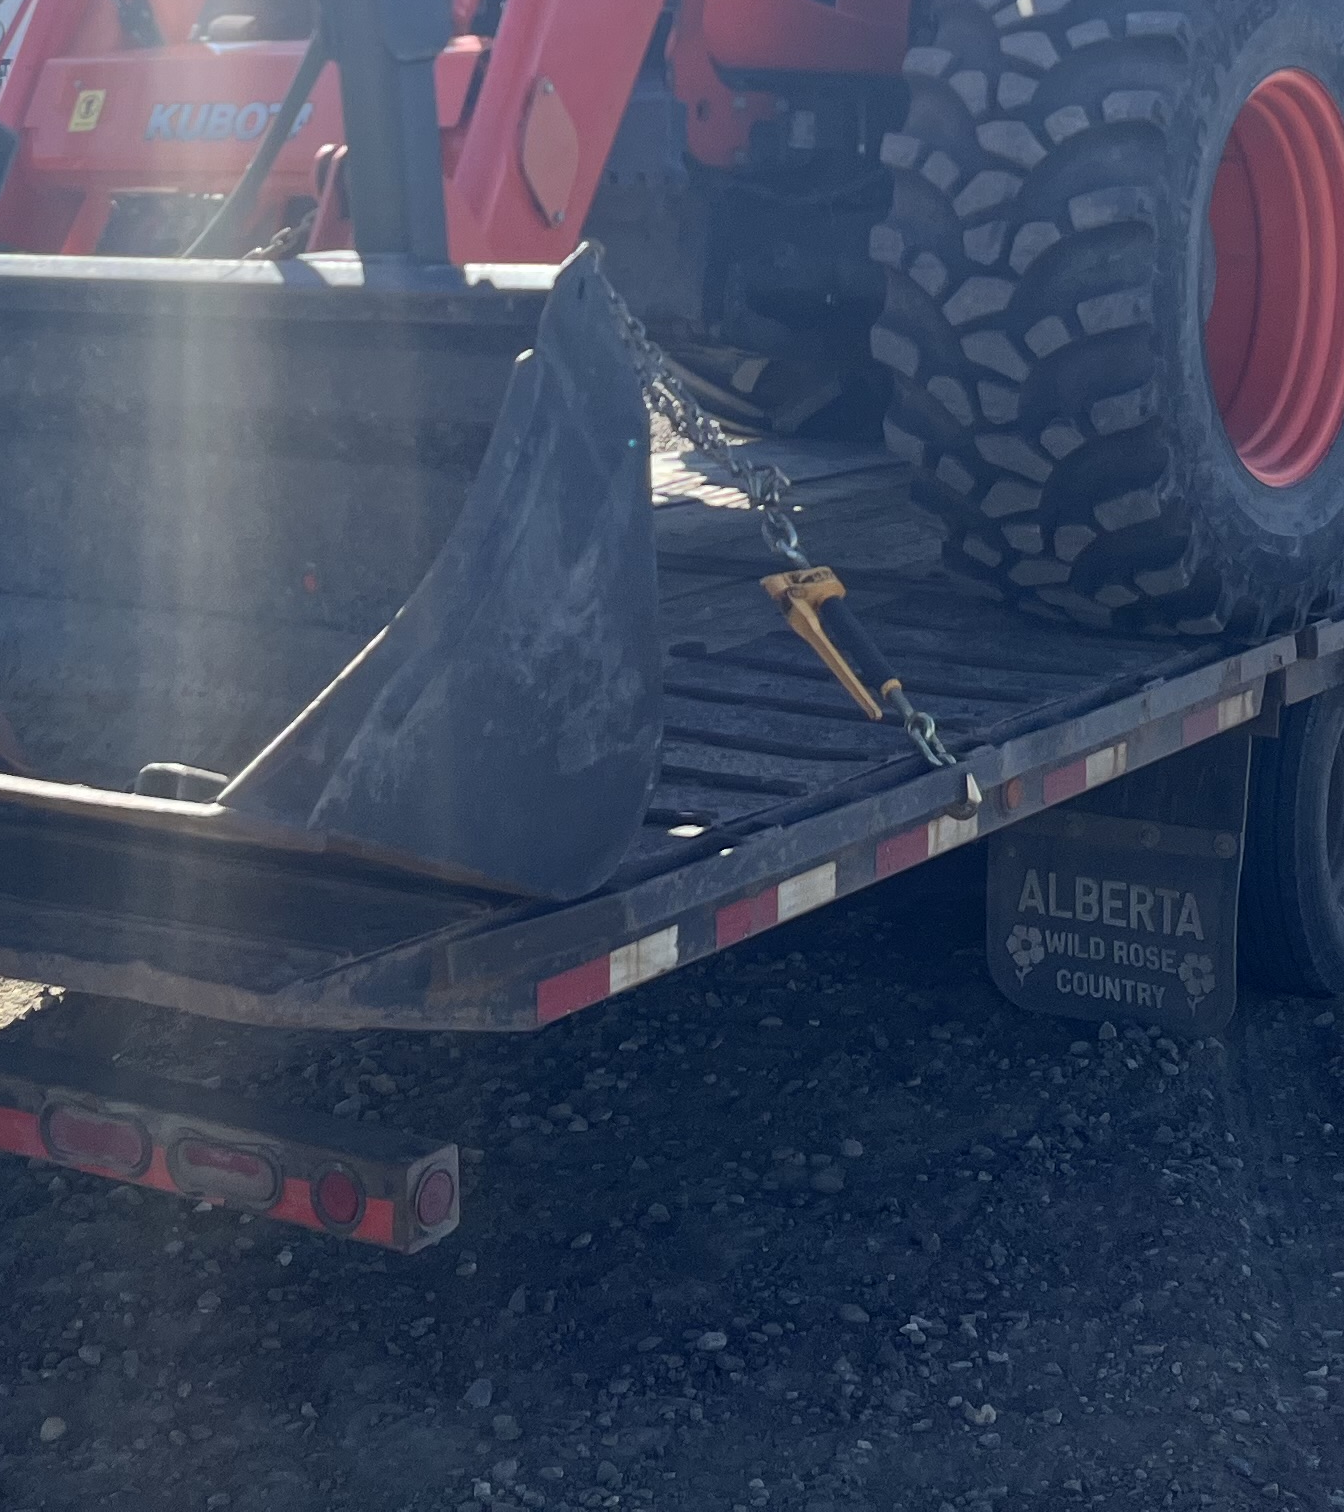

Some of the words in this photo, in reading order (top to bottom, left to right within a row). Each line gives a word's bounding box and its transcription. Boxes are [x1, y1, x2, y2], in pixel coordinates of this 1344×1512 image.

[1017, 868, 1205, 941] ALBERTA
[1045, 929, 1106, 960] WILD
[1113, 939, 1179, 975] ROSE
[1056, 968, 1167, 1010] COUNTRY
